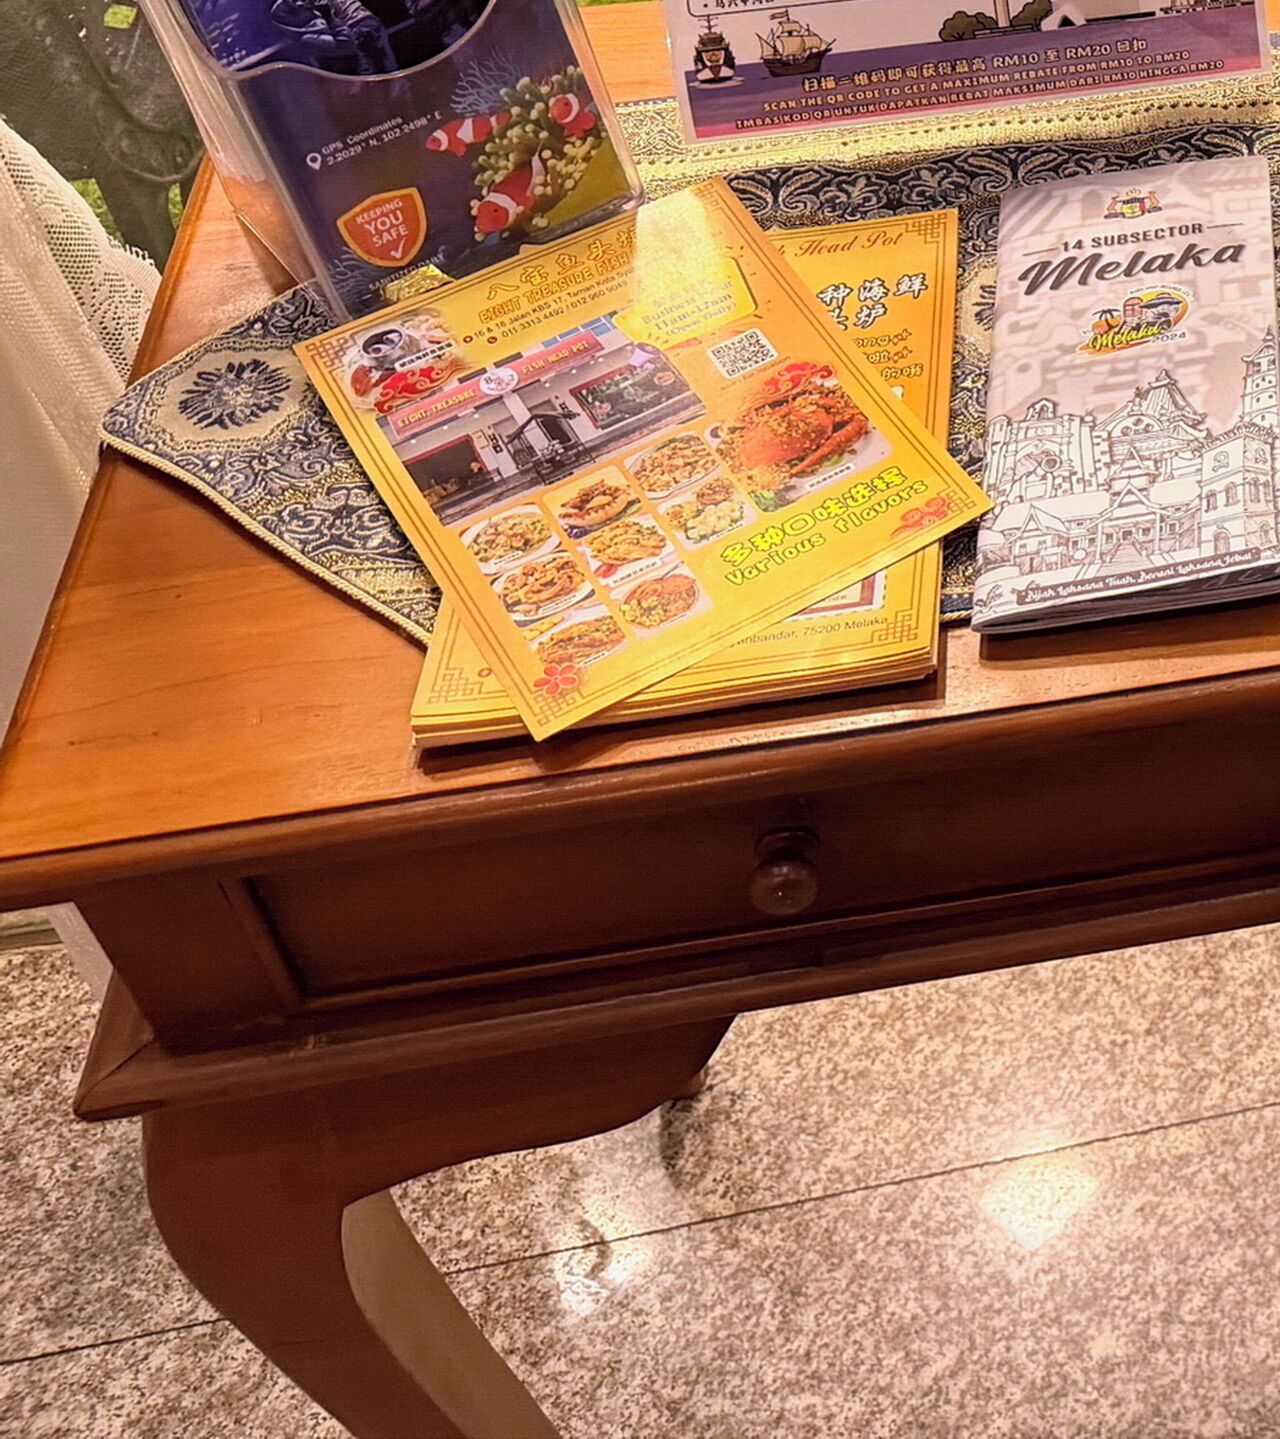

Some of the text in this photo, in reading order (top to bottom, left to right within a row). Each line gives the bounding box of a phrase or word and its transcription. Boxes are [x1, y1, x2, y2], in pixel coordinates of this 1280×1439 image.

[993, 52, 1039, 69] RM10
[1065, 42, 1111, 60] RM20
[355, 198, 403, 225] KEEPING
[364, 210, 403, 235] YOU
[373, 226, 408, 247] SAFE
[795, 231, 903, 257] Head Pot
[1062, 223, 1203, 252] 14 SUBSECTOR
[1018, 242, 1247, 295] Melaka
[478, 296, 521, 324] EIGHT
[522, 266, 592, 304] TREASURE
[1088, 324, 1165, 351] Melaka
[1152, 332, 1186, 343] 2024
[721, 466, 908, 566] 多种口味选择
[834, 481, 929, 533] flavors
[803, 616, 888, 637] 75200 Melaka
